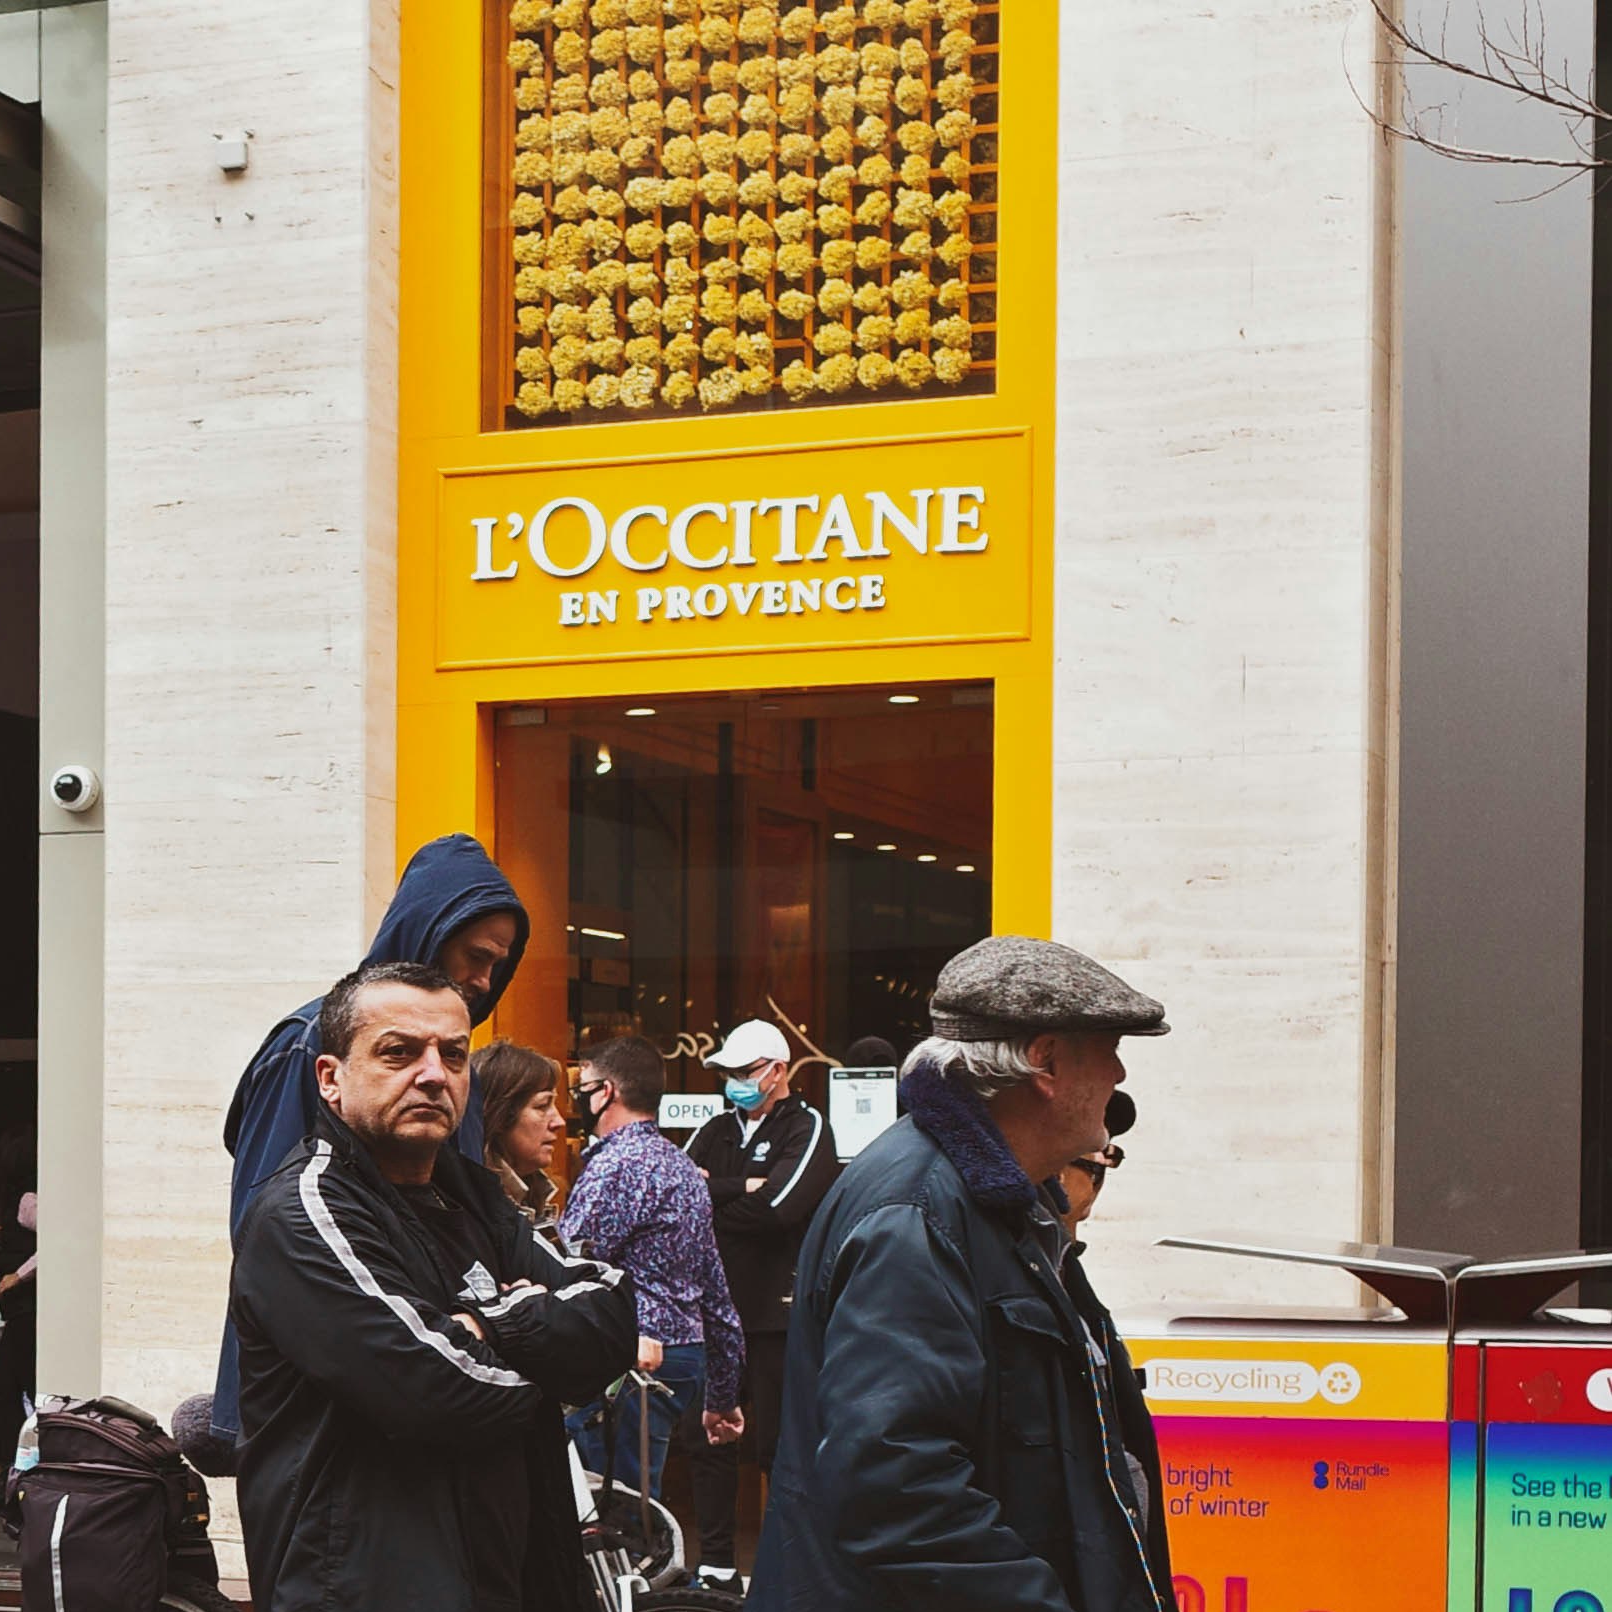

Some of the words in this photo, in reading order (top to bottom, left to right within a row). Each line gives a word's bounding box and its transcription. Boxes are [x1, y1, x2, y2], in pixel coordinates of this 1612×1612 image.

[471, 486, 989, 580] L'OCCITANE
[559, 590, 620, 626] EN
[636, 575, 886, 621] PROVENCE
[667, 1103, 714, 1119] OPEN
[1154, 1366, 1303, 1395] Recycling
[1166, 1463, 1233, 1492] bright
[1336, 1462, 1390, 1477] Rundle
[1336, 1476, 1367, 1491] Mall
[1511, 1473, 1556, 1498] See
[1563, 1474, 1603, 1499] the
[1169, 1494, 1193, 1516] of
[1199, 1496, 1270, 1518] winter
[1511, 1505, 1531, 1526] in
[1538, 1510, 1551, 1527] a
[1558, 1509, 1606, 1529] new
